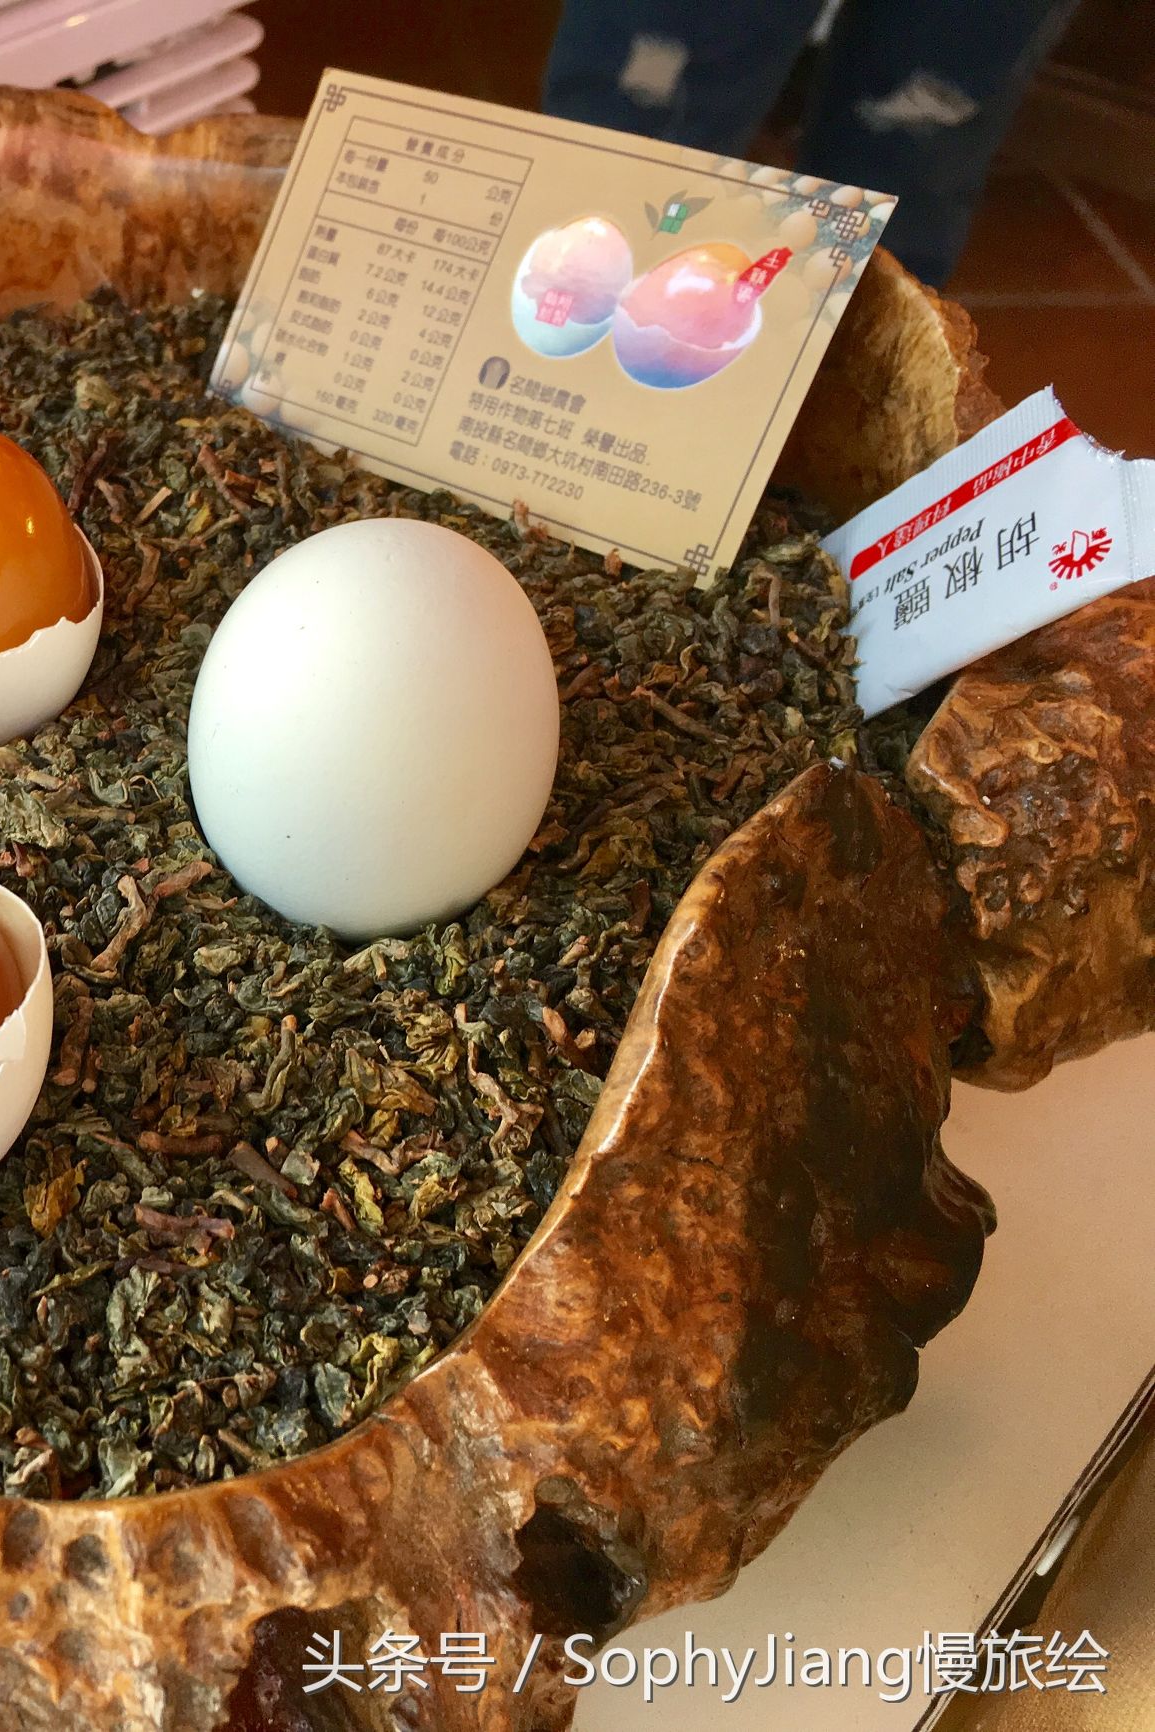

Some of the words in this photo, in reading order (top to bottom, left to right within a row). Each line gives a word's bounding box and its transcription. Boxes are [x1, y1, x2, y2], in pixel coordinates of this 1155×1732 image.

[973, 428, 1056, 496] 香中極品
[877, 498, 952, 558] 料理達人
[920, 517, 986, 569] Pepper
[884, 560, 918, 594] Salt
[894, 511, 1040, 631] 胡椒鹽
